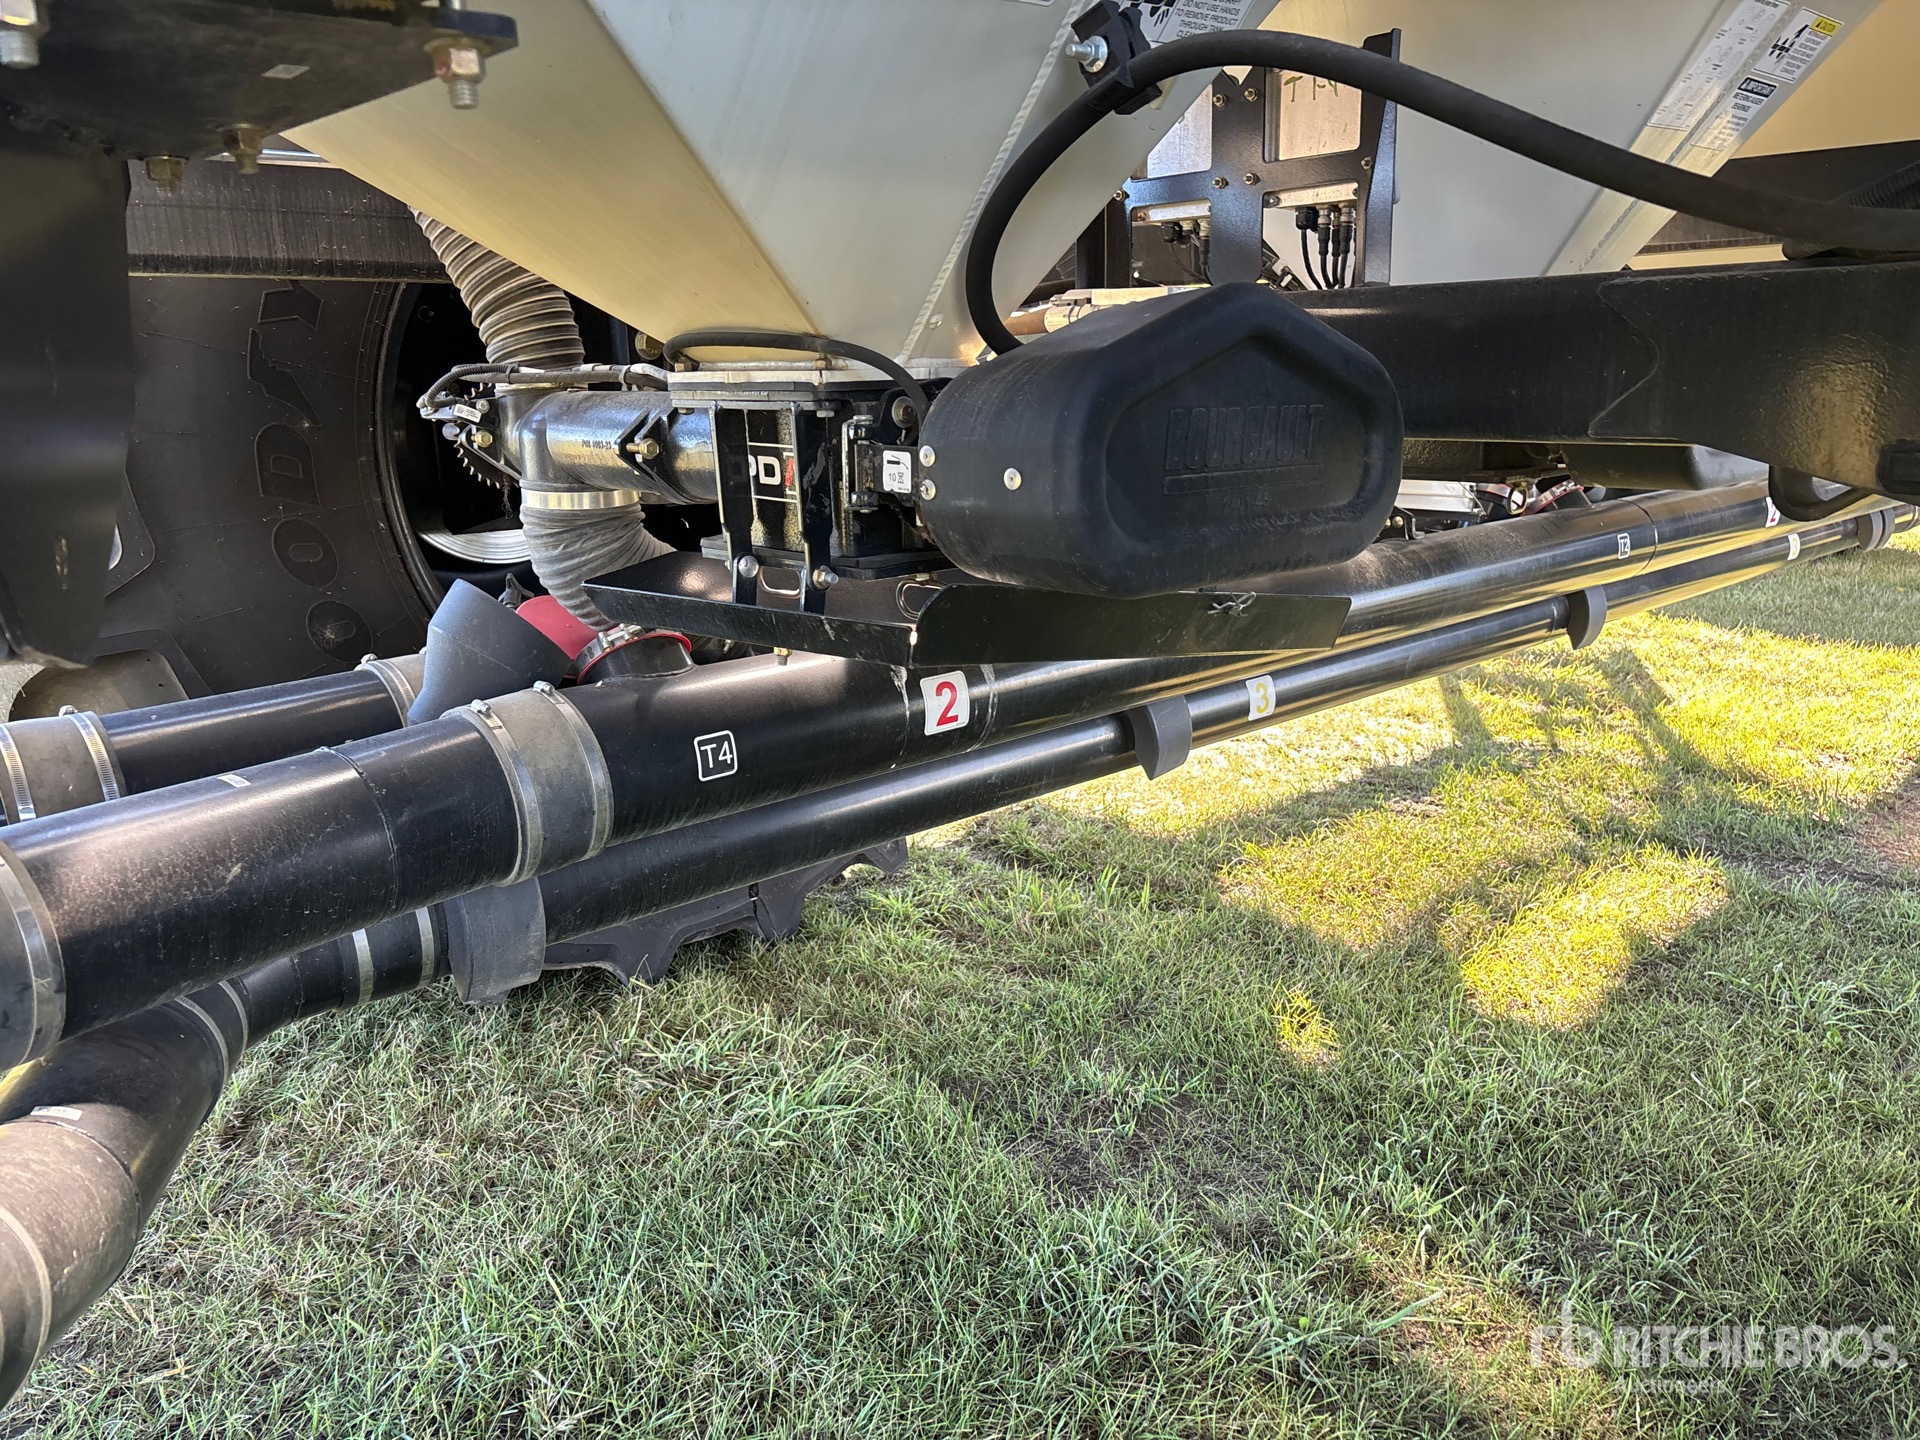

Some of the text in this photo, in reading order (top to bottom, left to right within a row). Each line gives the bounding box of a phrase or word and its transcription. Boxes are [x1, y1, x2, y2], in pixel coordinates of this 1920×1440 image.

[1191, 1, 1205, 10] NOT
[1206, 4, 1219, 12] USE
[1220, 6, 1240, 16] HANDS
[1174, 8, 1239, 26] TO REMOVE PRODUCT
[1179, 20, 1209, 31] THROUGH
[888, 472, 897, 482] 10
[1619, 539, 1629, 552] T2
[935, 681, 959, 726] 2
[1256, 682, 1270, 714] 3
[700, 740, 733, 769] T4
